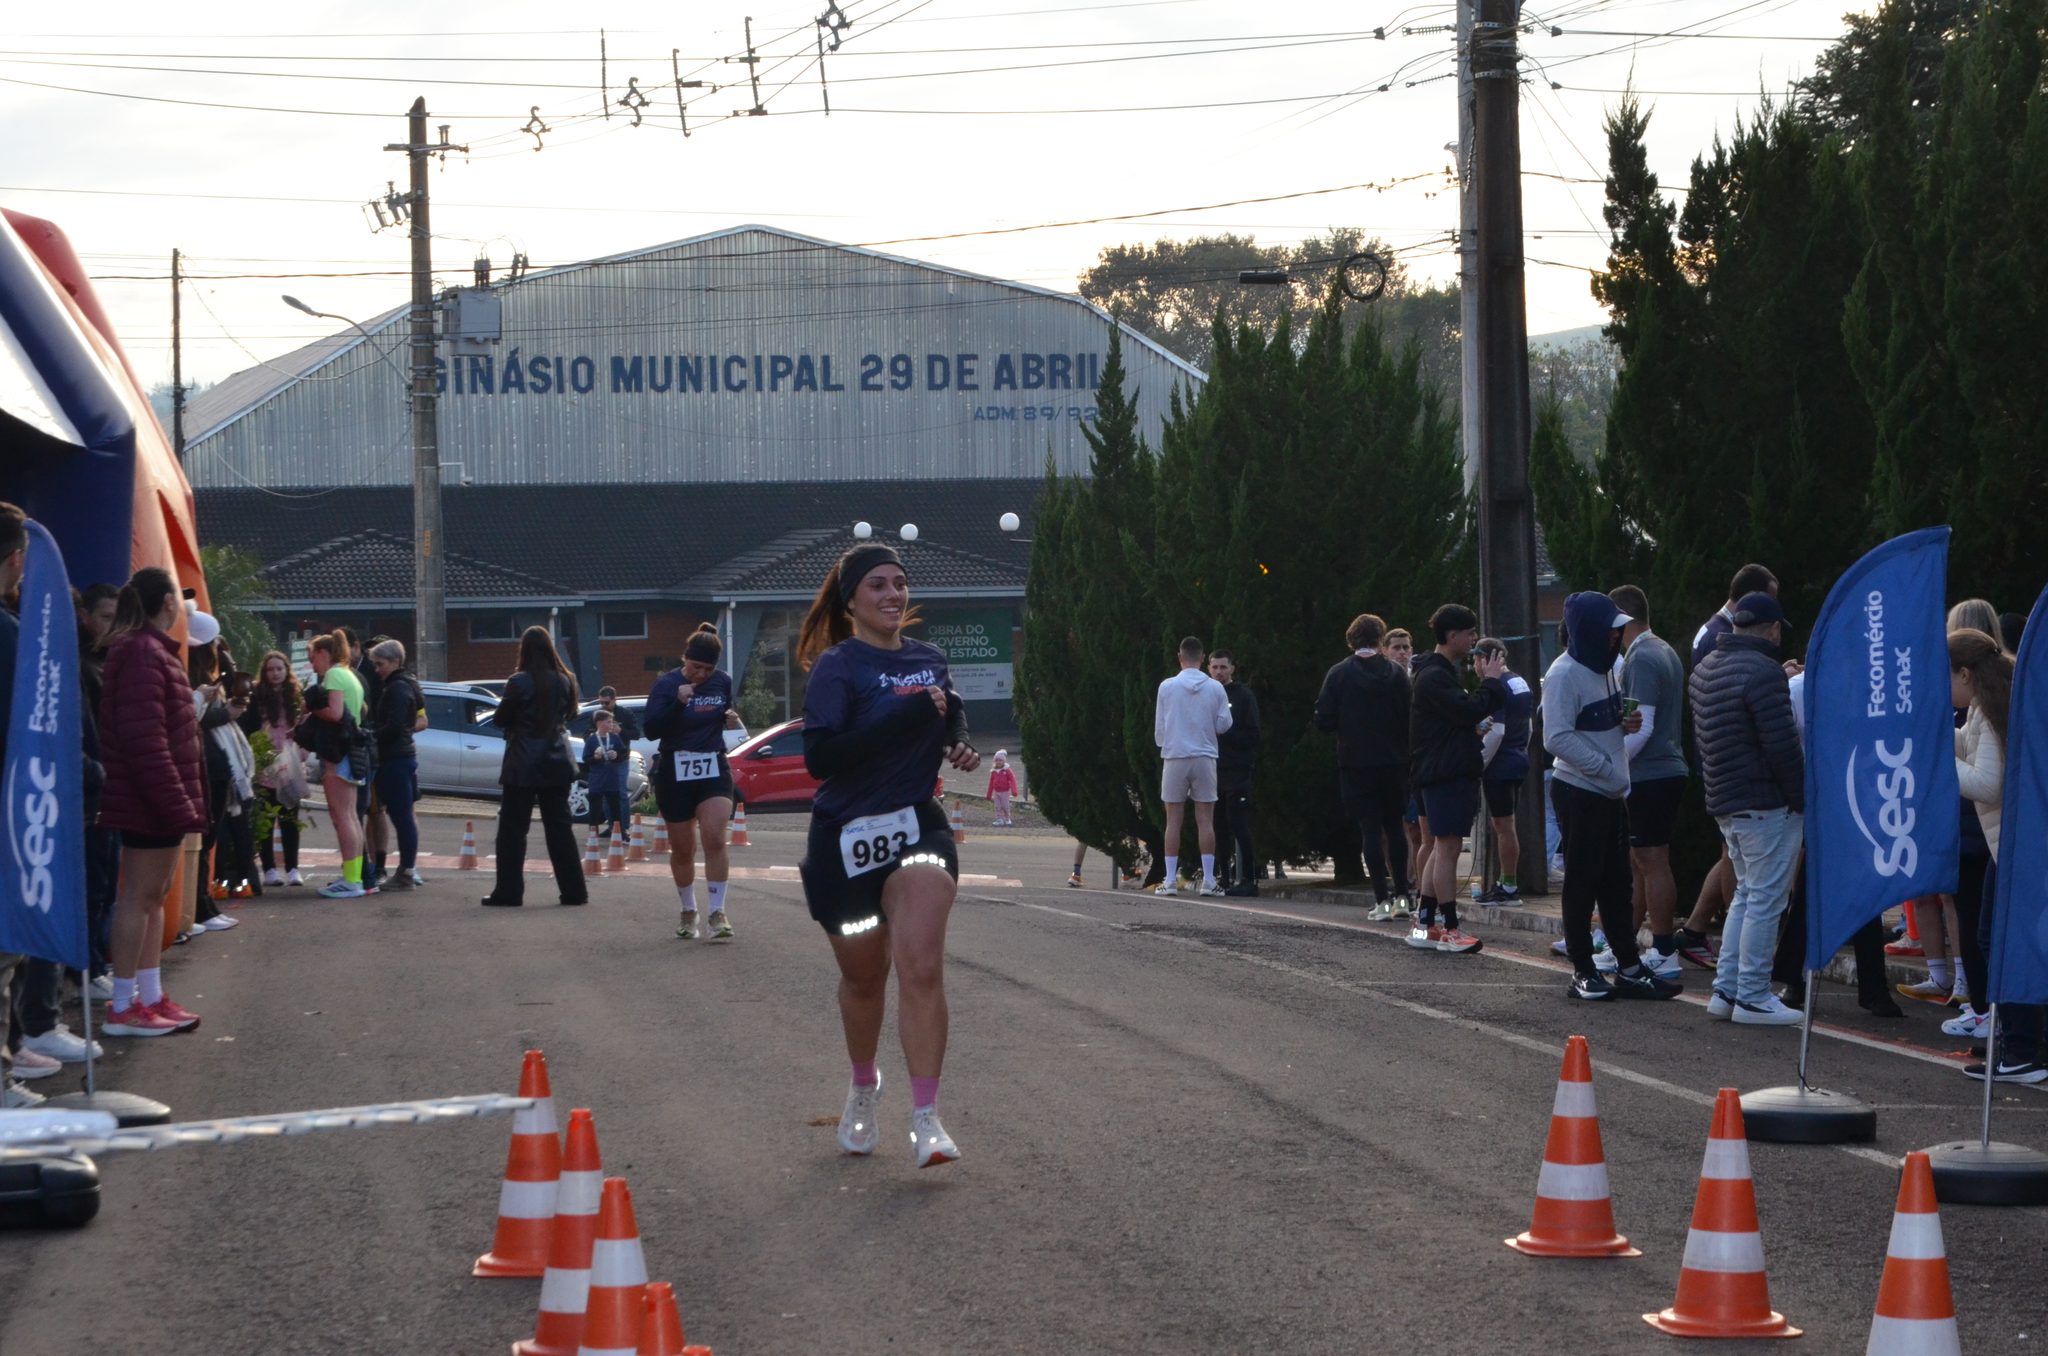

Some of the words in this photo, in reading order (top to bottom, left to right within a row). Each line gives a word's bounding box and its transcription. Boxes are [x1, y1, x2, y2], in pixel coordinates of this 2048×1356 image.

[611, 354, 845, 393] MUNICIPAL
[860, 354, 913, 391] 29
[927, 354, 979, 391] DE
[928, 625, 962, 635] OBRA
[966, 624, 984, 635] DO
[950, 647, 998, 658] ESTADO
[1863, 590, 1887, 718] Fecomércio
[680, 757, 712, 777] 757
